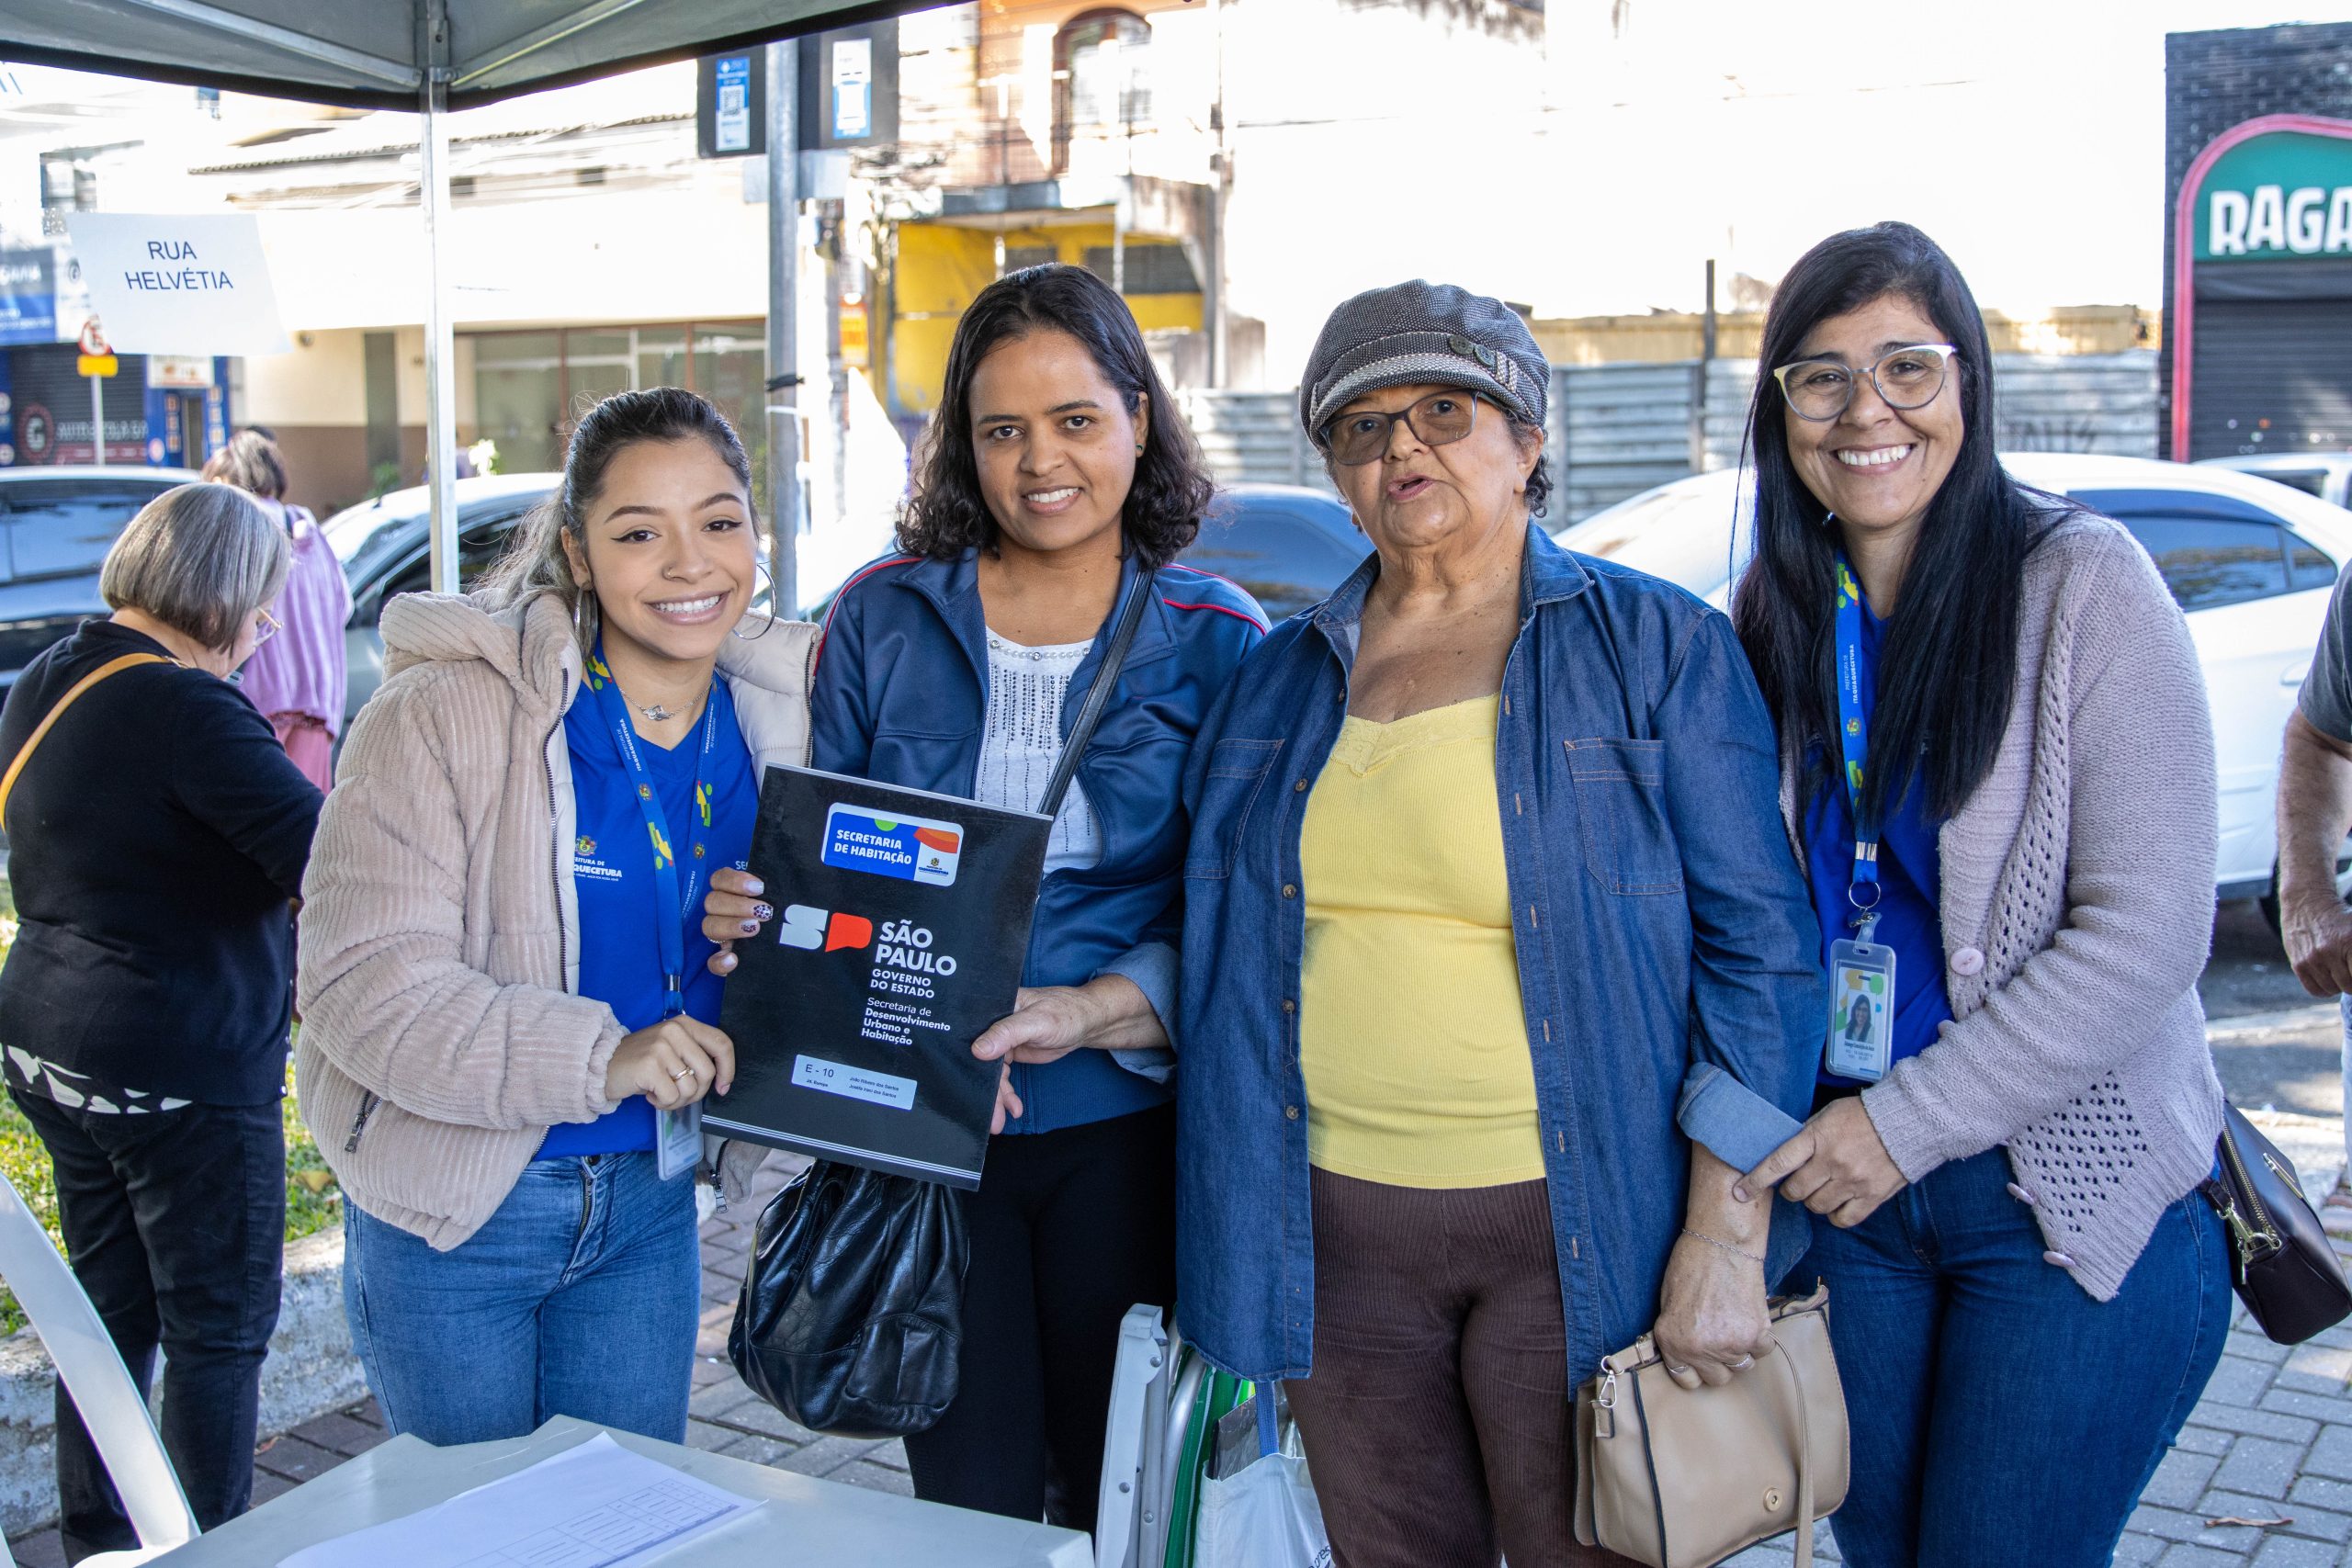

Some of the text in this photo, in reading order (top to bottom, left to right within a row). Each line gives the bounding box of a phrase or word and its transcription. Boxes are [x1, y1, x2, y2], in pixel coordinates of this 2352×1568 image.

[2209, 184, 2352, 255] RAGA
[147, 241, 198, 260] RUA
[125, 267, 233, 289] HELVÉTIA
[836, 829, 902, 850] SECRETARIA
[833, 842, 912, 864] DE HABITAÇÃO
[879, 919, 933, 949] SÃO
[875, 943, 957, 976] PAULO
[872, 968, 932, 987] GOVERNO
[870, 979, 935, 998] DO ESTADO
[867, 997, 932, 1017] Secretaria de
[863, 1017, 910, 1034] Urbano e
[865, 1007, 951, 1032] Desenvolvimento
[861, 1027, 913, 1045] Habitação
[805, 1064, 813, 1073] E
[822, 1067, 834, 1078] 10
